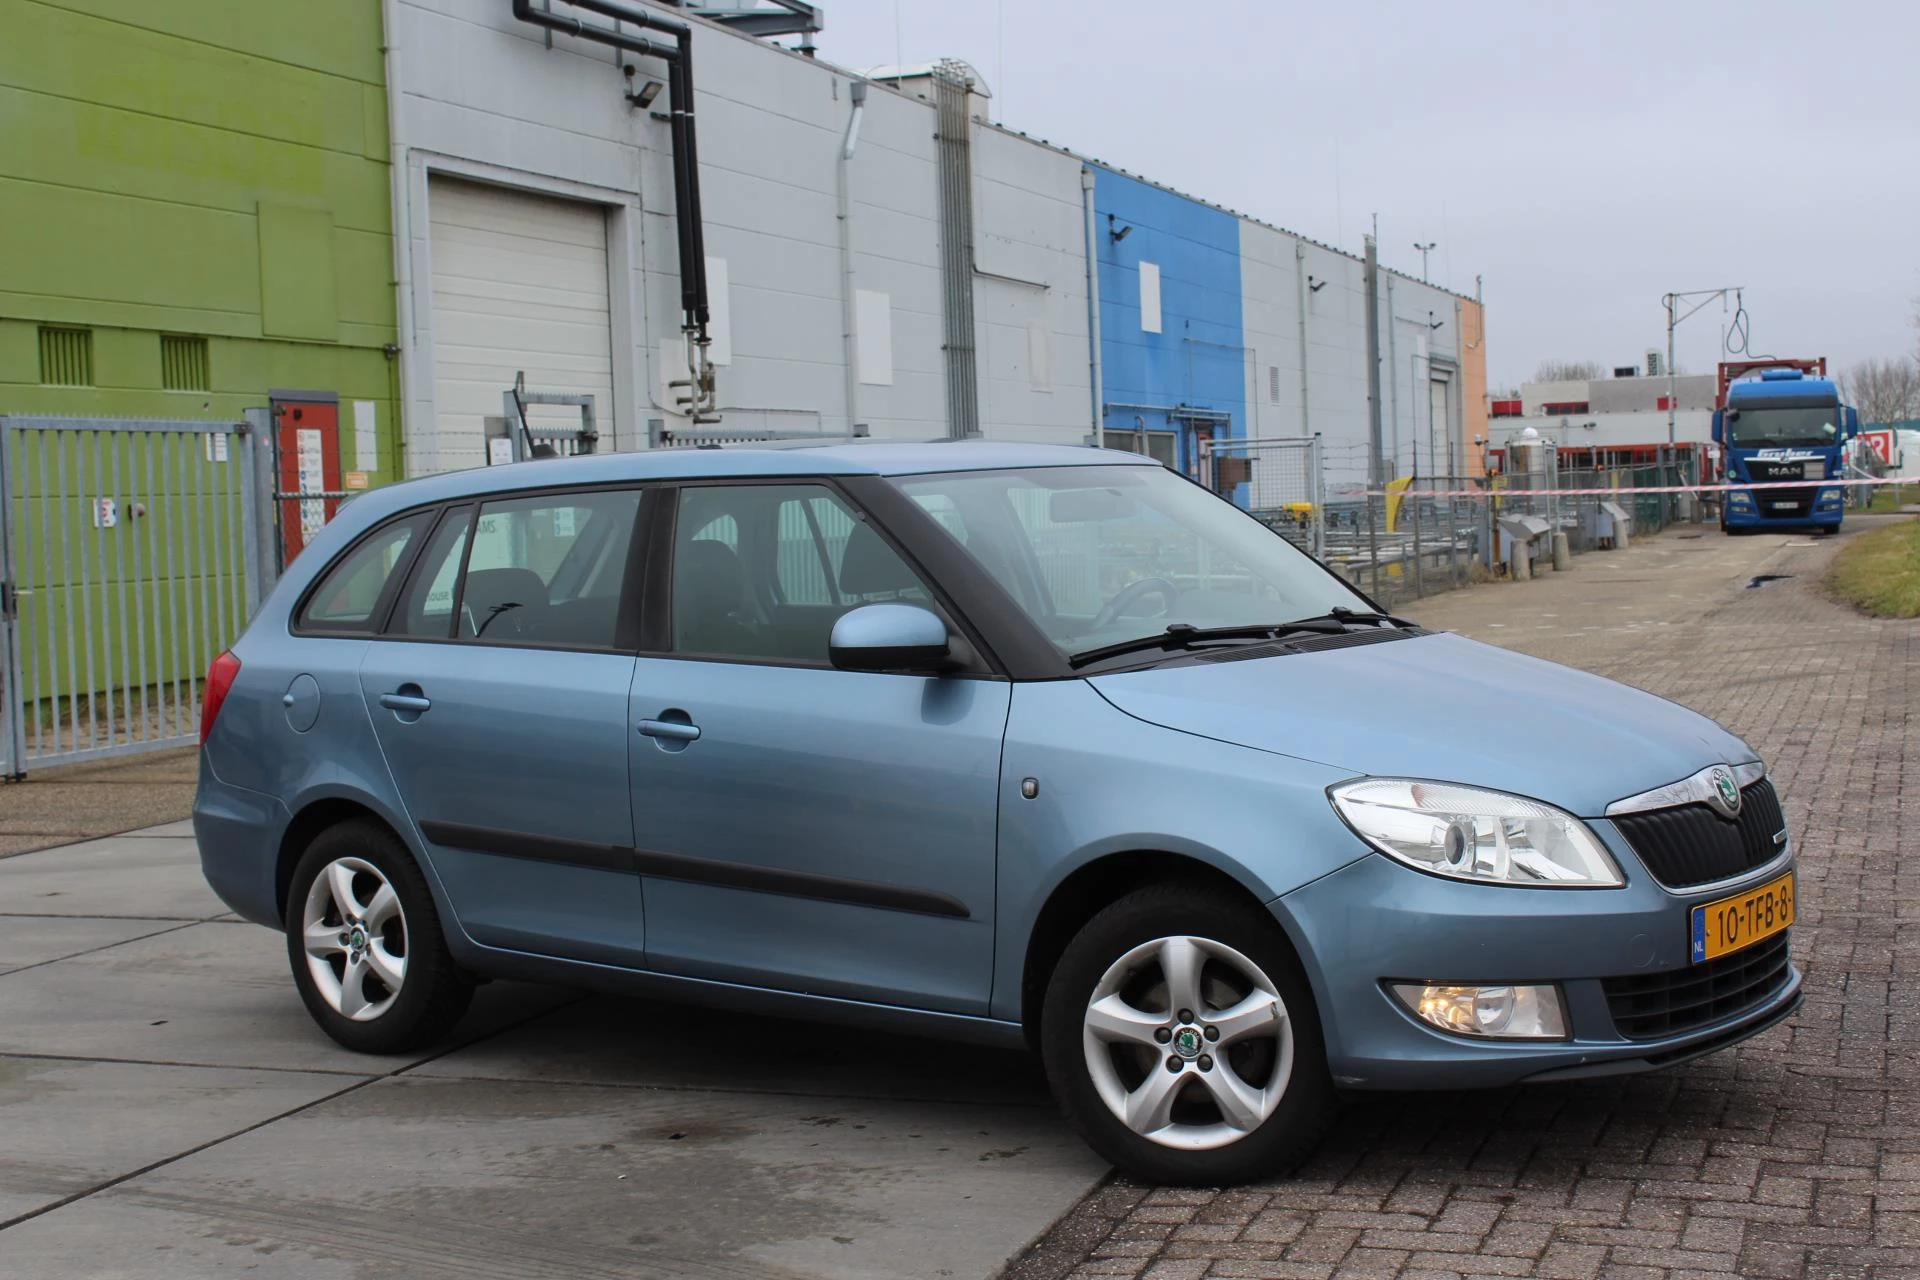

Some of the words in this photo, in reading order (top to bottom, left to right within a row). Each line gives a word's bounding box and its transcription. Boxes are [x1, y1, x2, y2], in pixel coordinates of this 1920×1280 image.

[1757, 448, 1814, 458] Gruber
[1768, 467, 1801, 476] MAN
[1718, 885, 1787, 947] 10-TFB-8
[1694, 941, 1703, 953] NL
